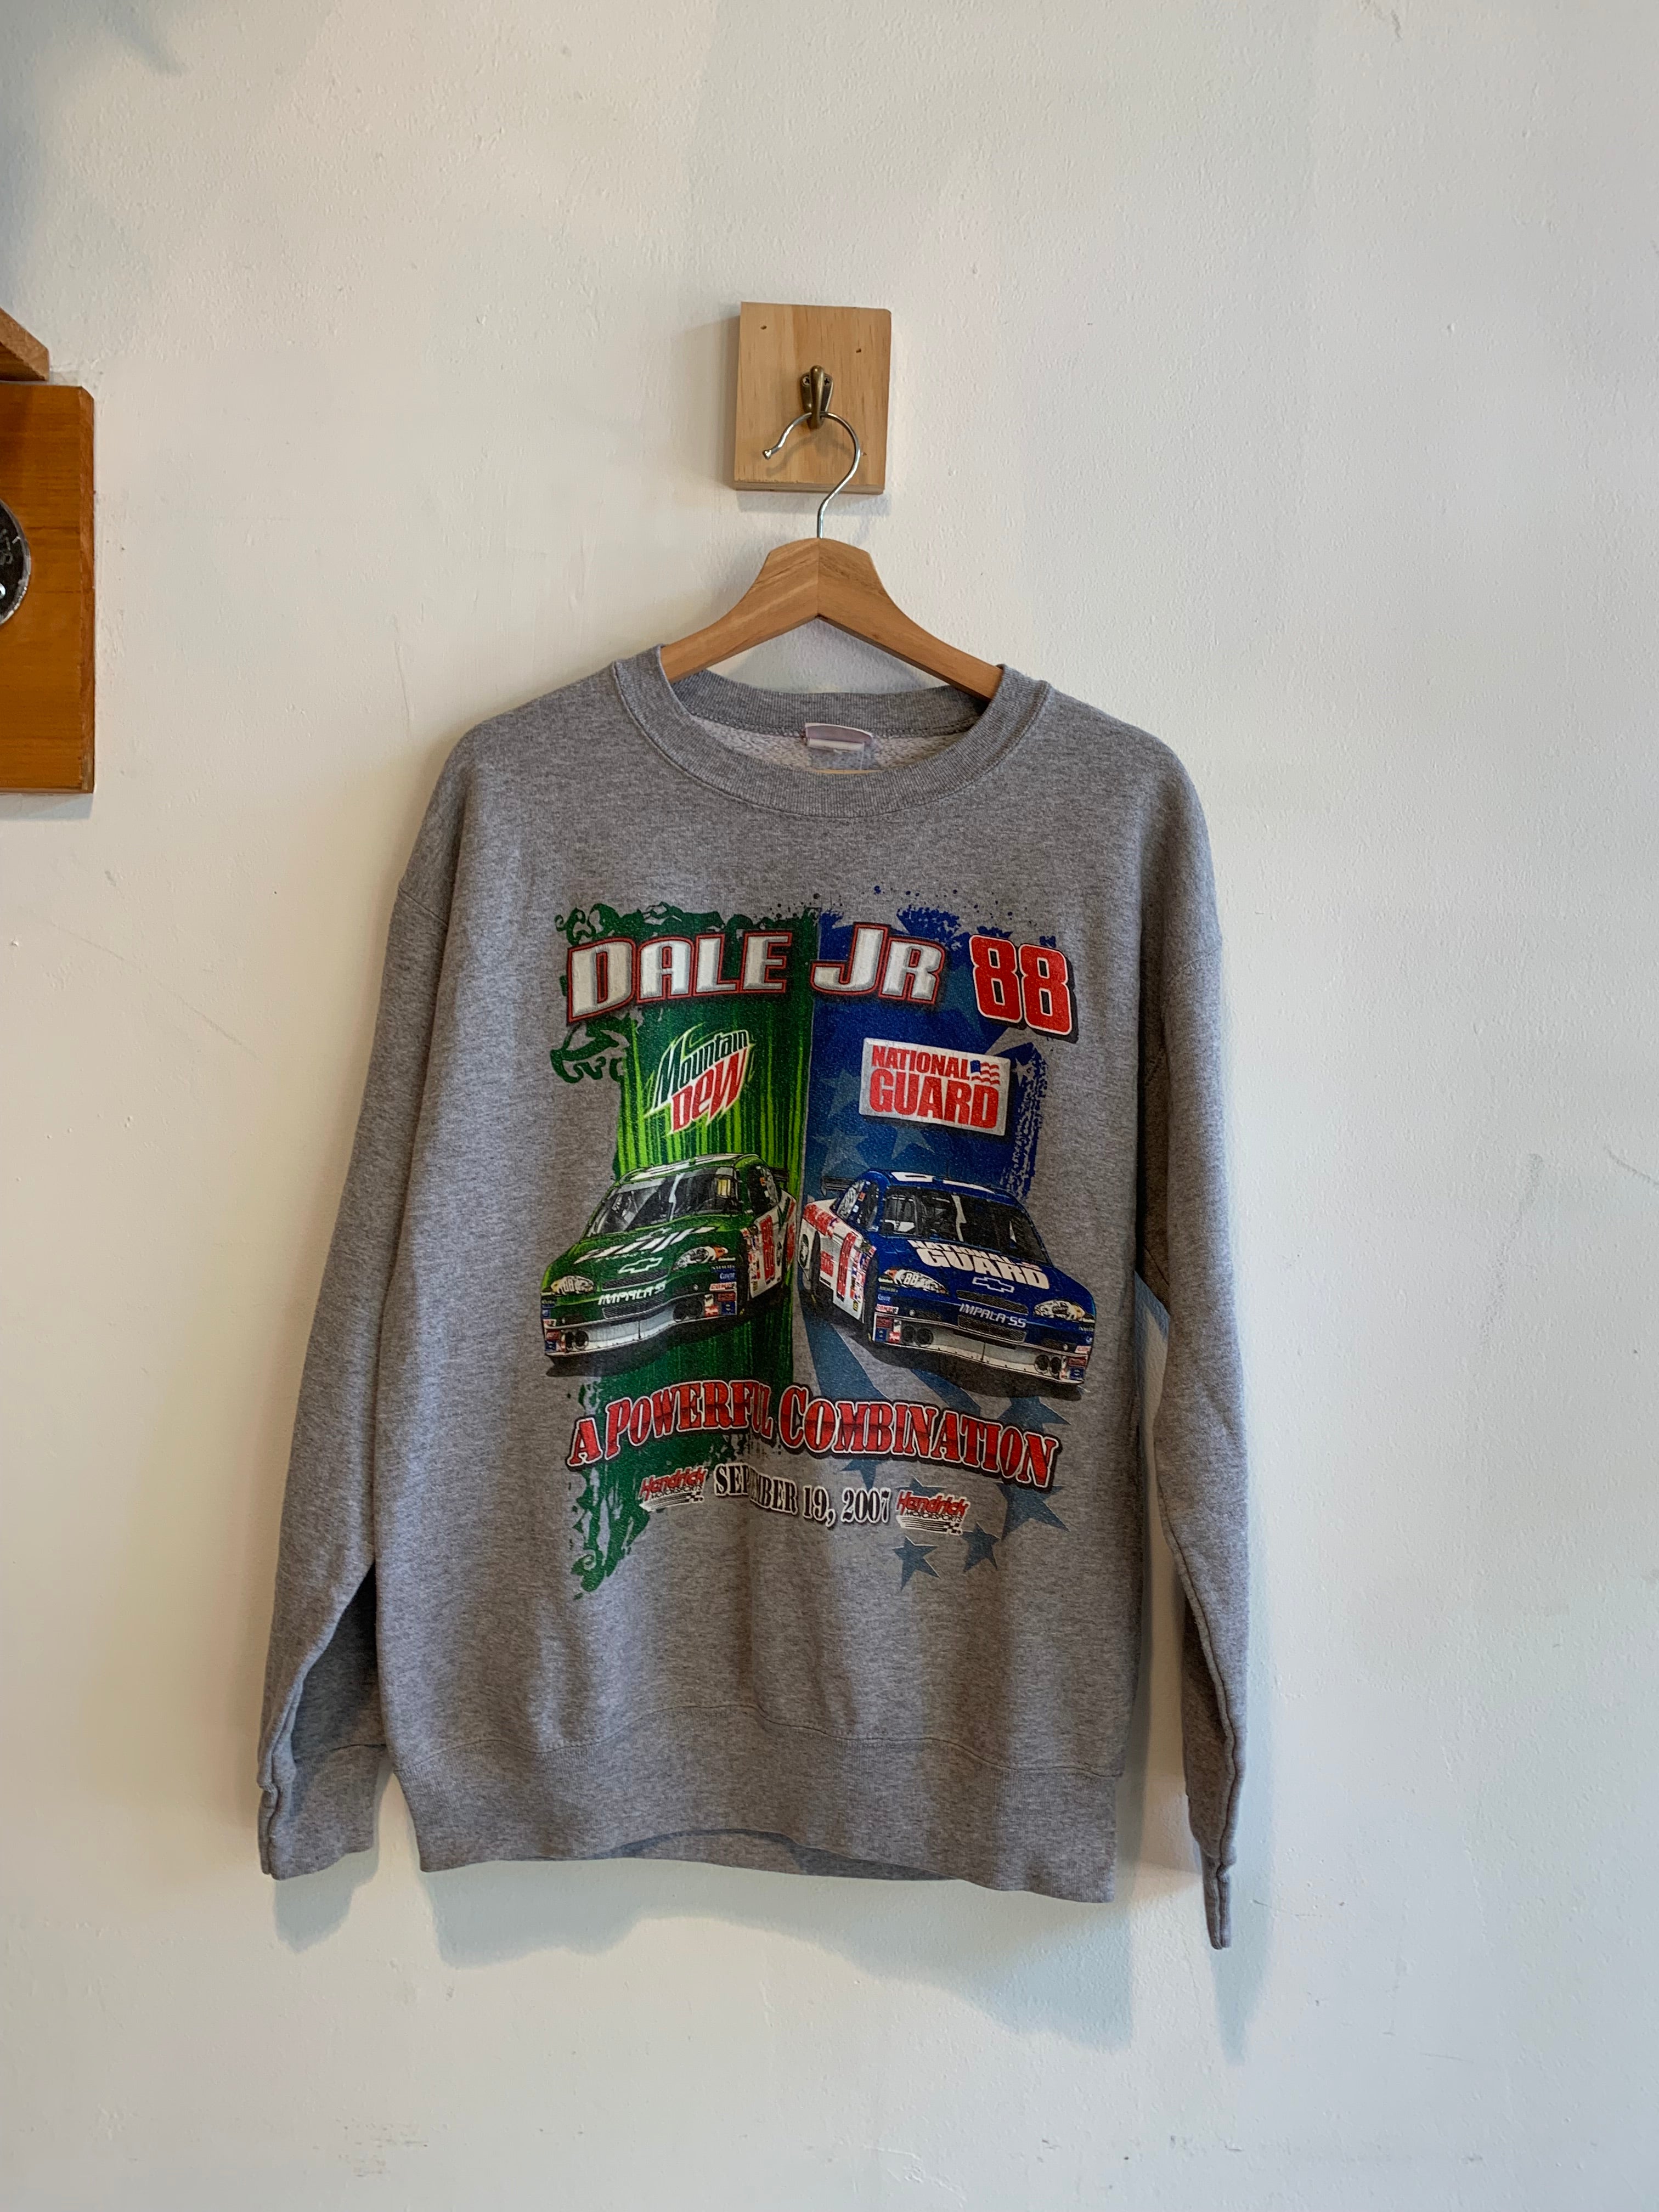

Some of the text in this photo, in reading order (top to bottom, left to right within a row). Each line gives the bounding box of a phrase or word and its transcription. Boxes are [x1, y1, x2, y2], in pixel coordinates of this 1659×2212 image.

[567, 932, 793, 1024] DALE
[969, 933, 1074, 1036] 88
[652, 1030, 749, 1110] Mountain
[871, 1045, 971, 1081] NATIONAL
[868, 1069, 1000, 1130] GUARD
[907, 1239, 1015, 1264] NATIONAL
[916, 1248, 1050, 1290] GUARD
[959, 1303, 1027, 1328] IMPALA SS
[567, 1417, 603, 1467] A
[778, 1384, 1058, 1488] COMBINATION
[638, 1465, 708, 1502] Hendrick
[896, 1489, 970, 1518] Hendrick
[802, 1485, 836, 1528] 19,
[840, 1487, 891, 1525] 2007
